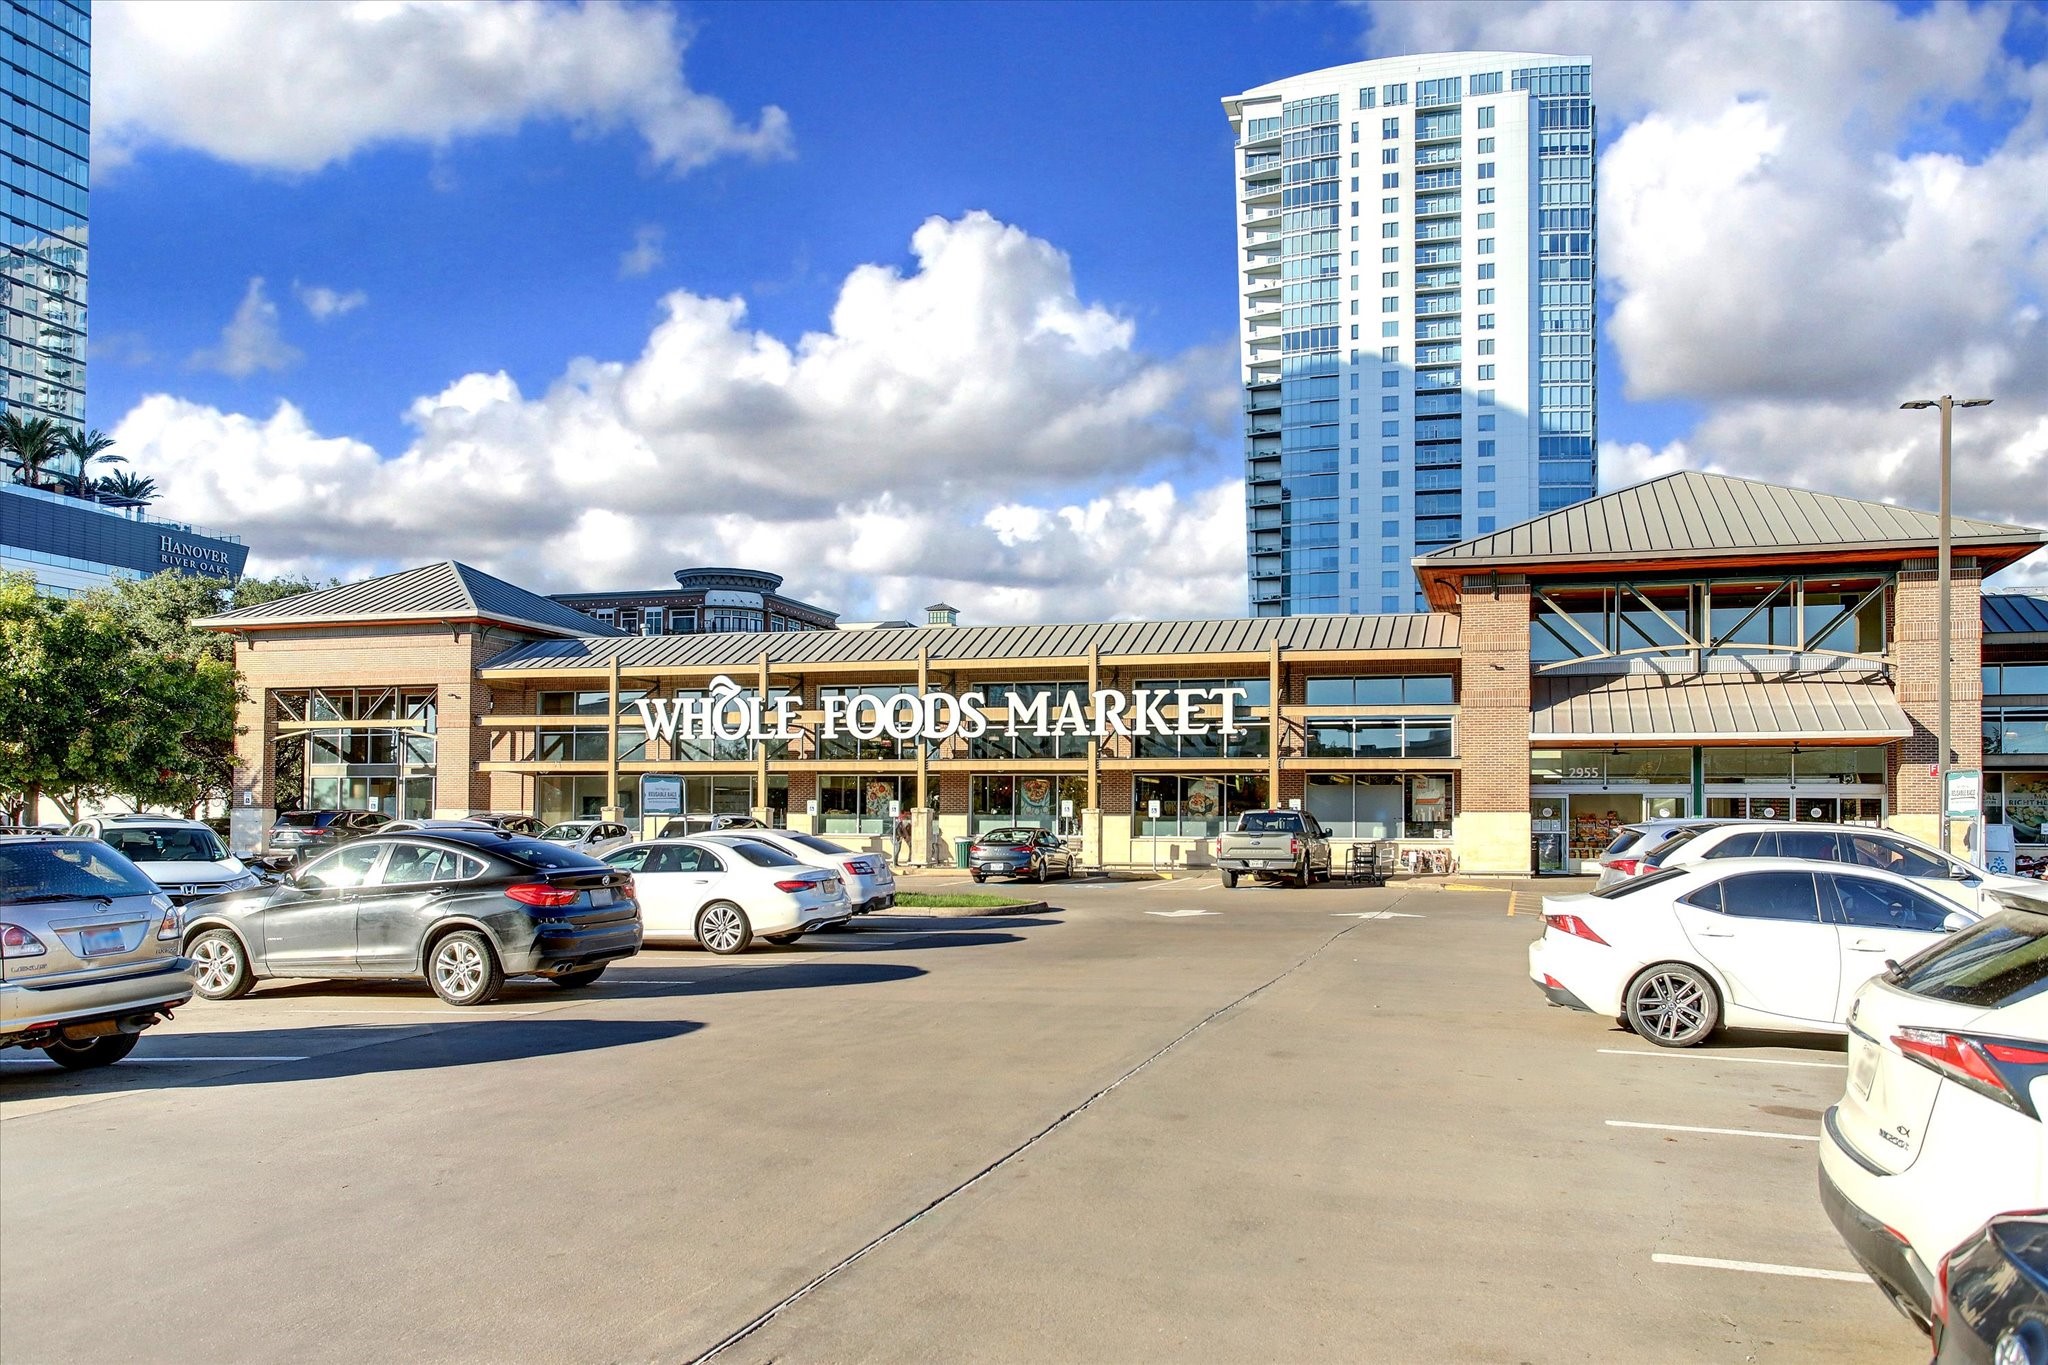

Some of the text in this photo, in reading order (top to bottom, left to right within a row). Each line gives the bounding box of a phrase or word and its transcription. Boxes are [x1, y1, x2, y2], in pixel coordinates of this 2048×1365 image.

[160, 535, 229, 564] HANOVER
[161, 554, 230, 575] RIVER OAKS
[634, 675, 1248, 741] WHOLE FOODS MARKET
[1568, 767, 1599, 779] 2955
